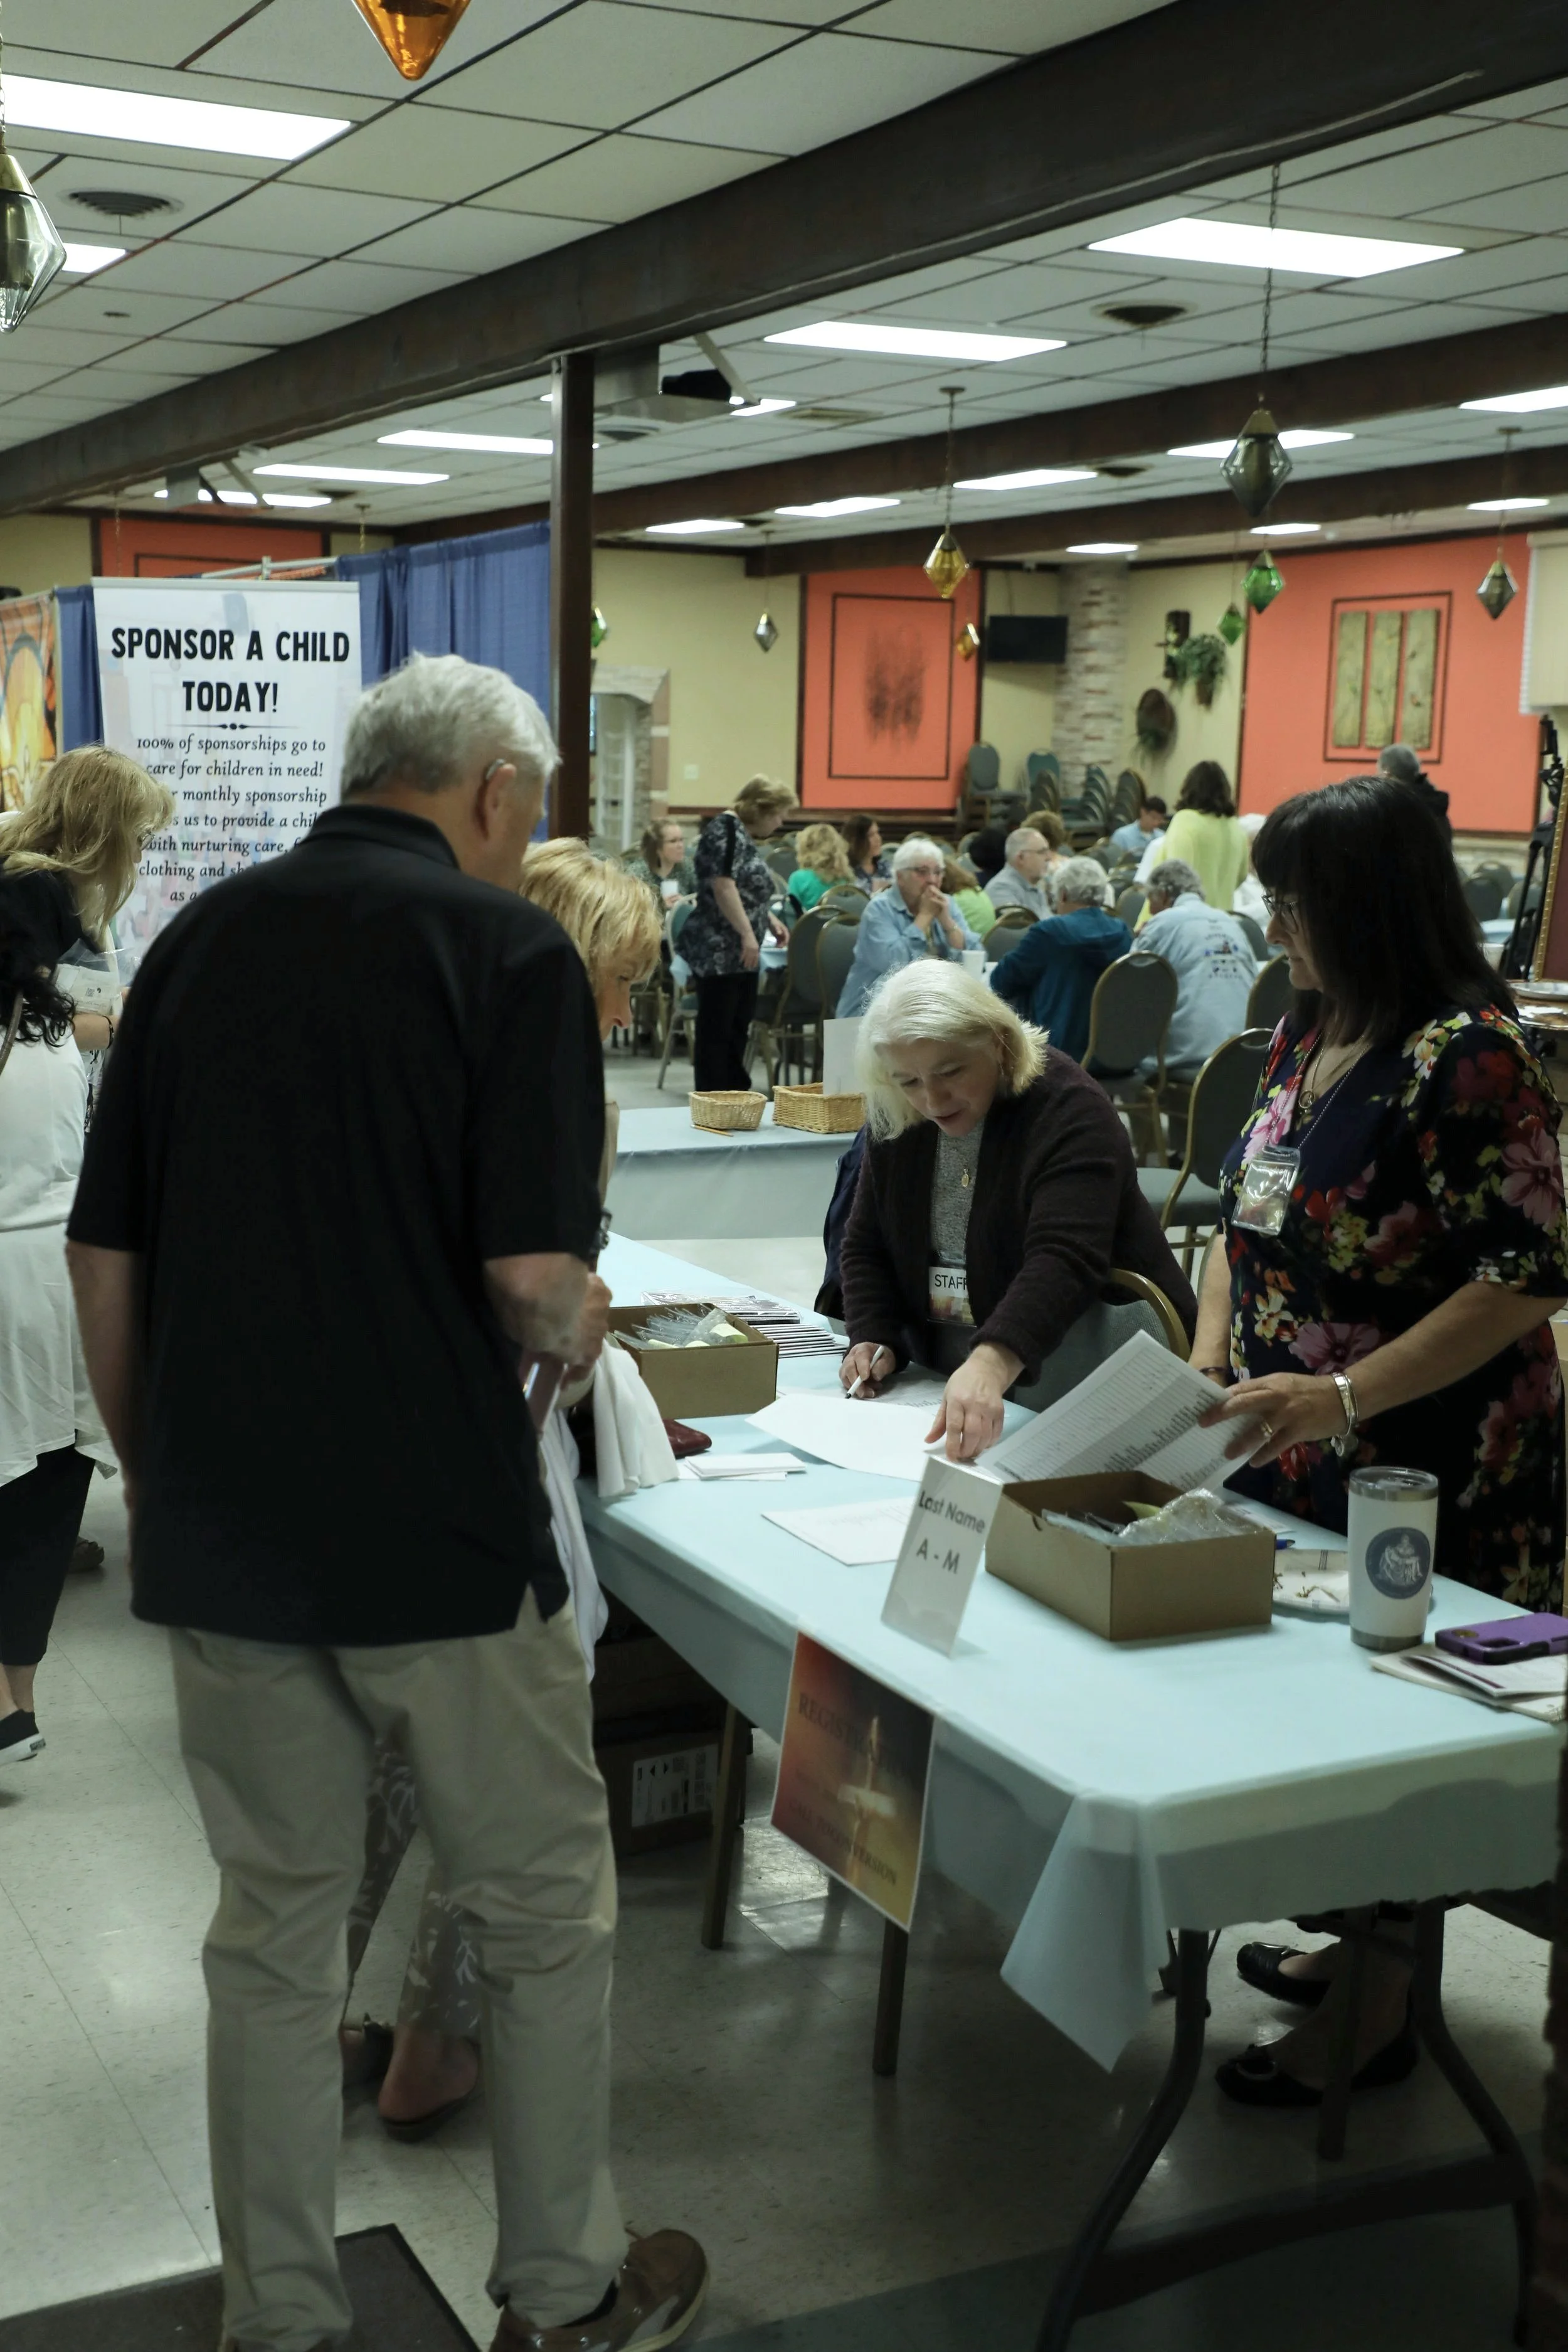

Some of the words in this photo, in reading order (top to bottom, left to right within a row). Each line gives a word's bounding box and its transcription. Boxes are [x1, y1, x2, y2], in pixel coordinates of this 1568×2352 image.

[111, 627, 234, 660] SPONSOR
[246, 631, 263, 661] A
[276, 631, 350, 662] CHILD
[183, 681, 278, 713] TODAY!
[137, 738, 174, 749] 100%
[179, 733, 194, 753] of
[198, 735, 287, 755] sponsorships
[291, 740, 307, 755] go
[312, 739, 326, 751] to
[146, 765, 176, 775] care
[179, 759, 202, 780] for
[206, 759, 263, 775] children
[268, 762, 282, 775] in
[287, 762, 324, 777] need!
[183, 785, 240, 806] monthly
[245, 787, 327, 807] sponsorship
[184, 817, 199, 826] us
[204, 814, 217, 826] to
[222, 813, 275, 831] provide
[279, 818, 287, 827] a
[292, 812, 317, 827] chil
[181, 837, 250, 856] nurturing
[255, 841, 289, 854] care,
[139, 860, 194, 881] clothing
[199, 861, 225, 877] and
[170, 891, 185, 901] as
[919, 1490, 945, 1514] Last
[945, 1501, 985, 1534] Name
[916, 1538, 928, 1560] A
[943, 1549, 960, 1574] M
[798, 1691, 911, 1785] REGISTRATIO
